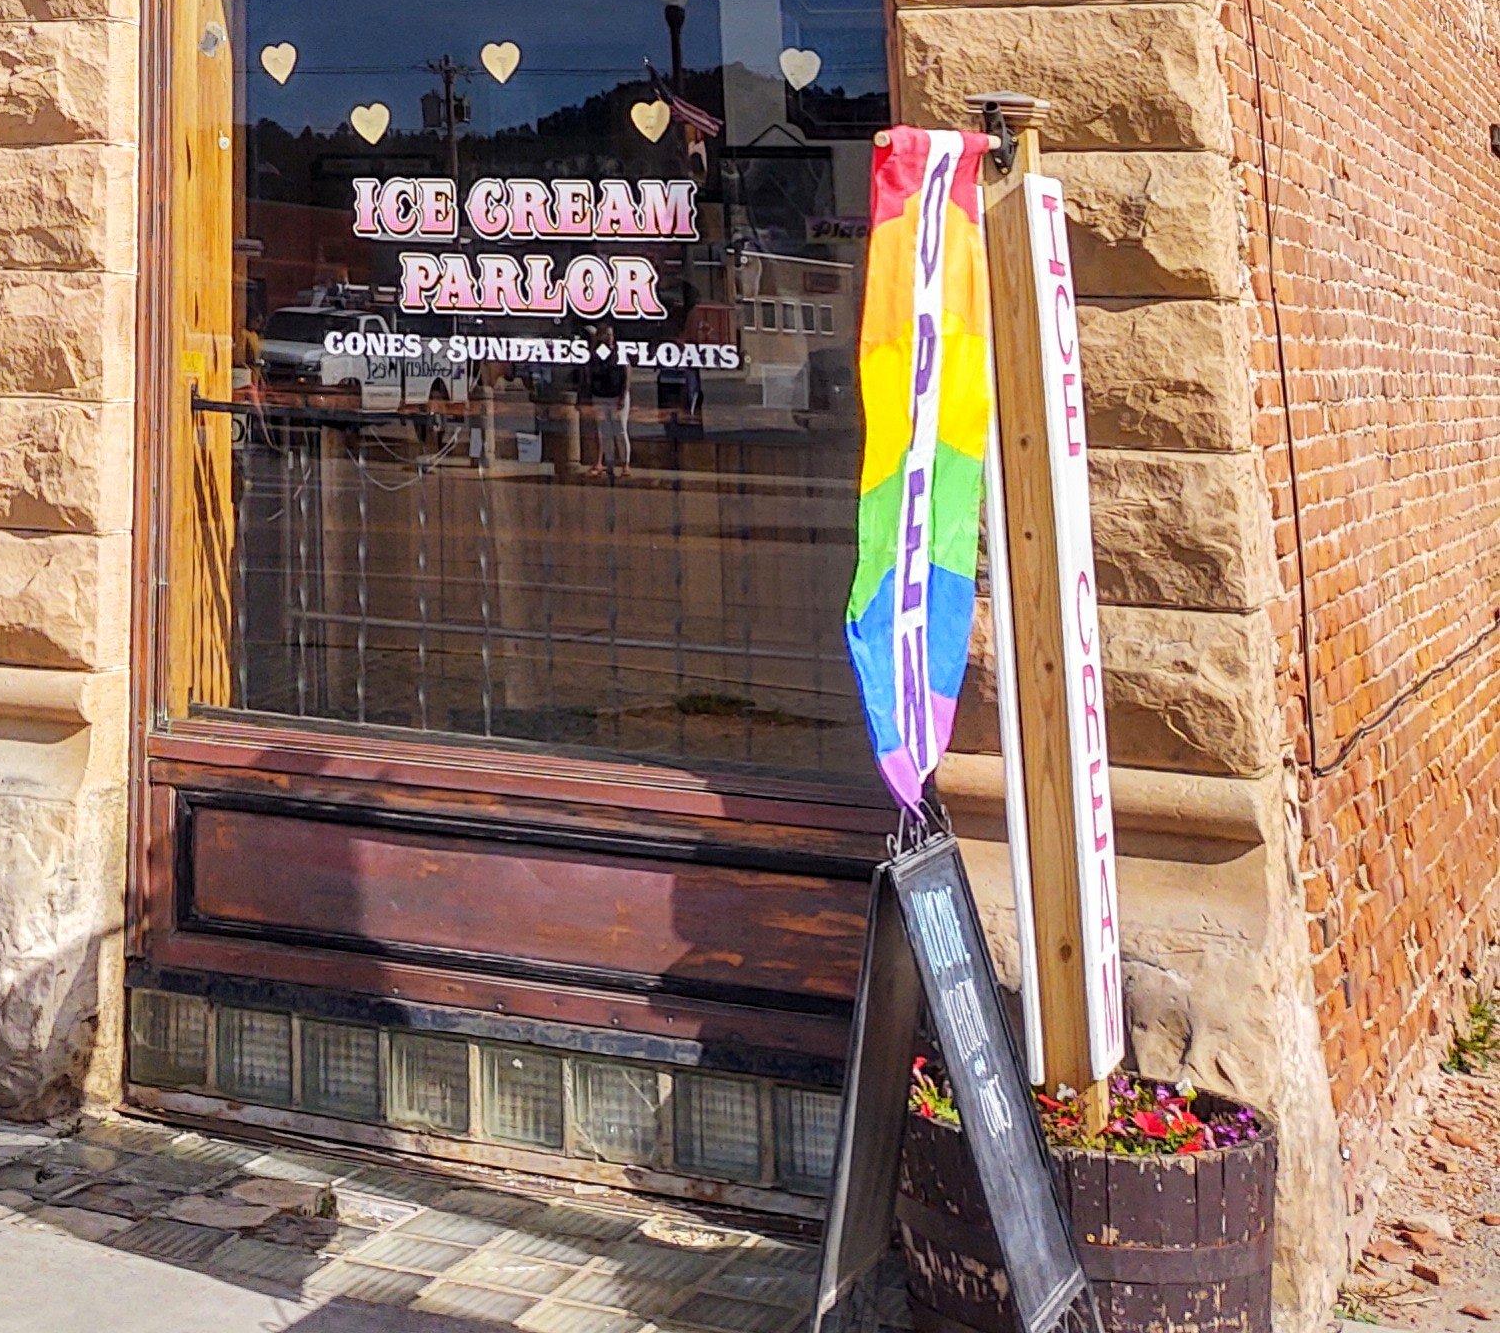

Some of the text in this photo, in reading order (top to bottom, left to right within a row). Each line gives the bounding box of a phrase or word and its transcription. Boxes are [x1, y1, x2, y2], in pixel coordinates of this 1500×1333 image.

[352, 176, 699, 241] ICE CREAM
[400, 251, 668, 320] PARLOR
[323, 330, 740, 369] CONES SUNDAES FLOATS
[903, 151, 950, 771] OPEN
[1041, 193, 1122, 1055] ICE CREAM
